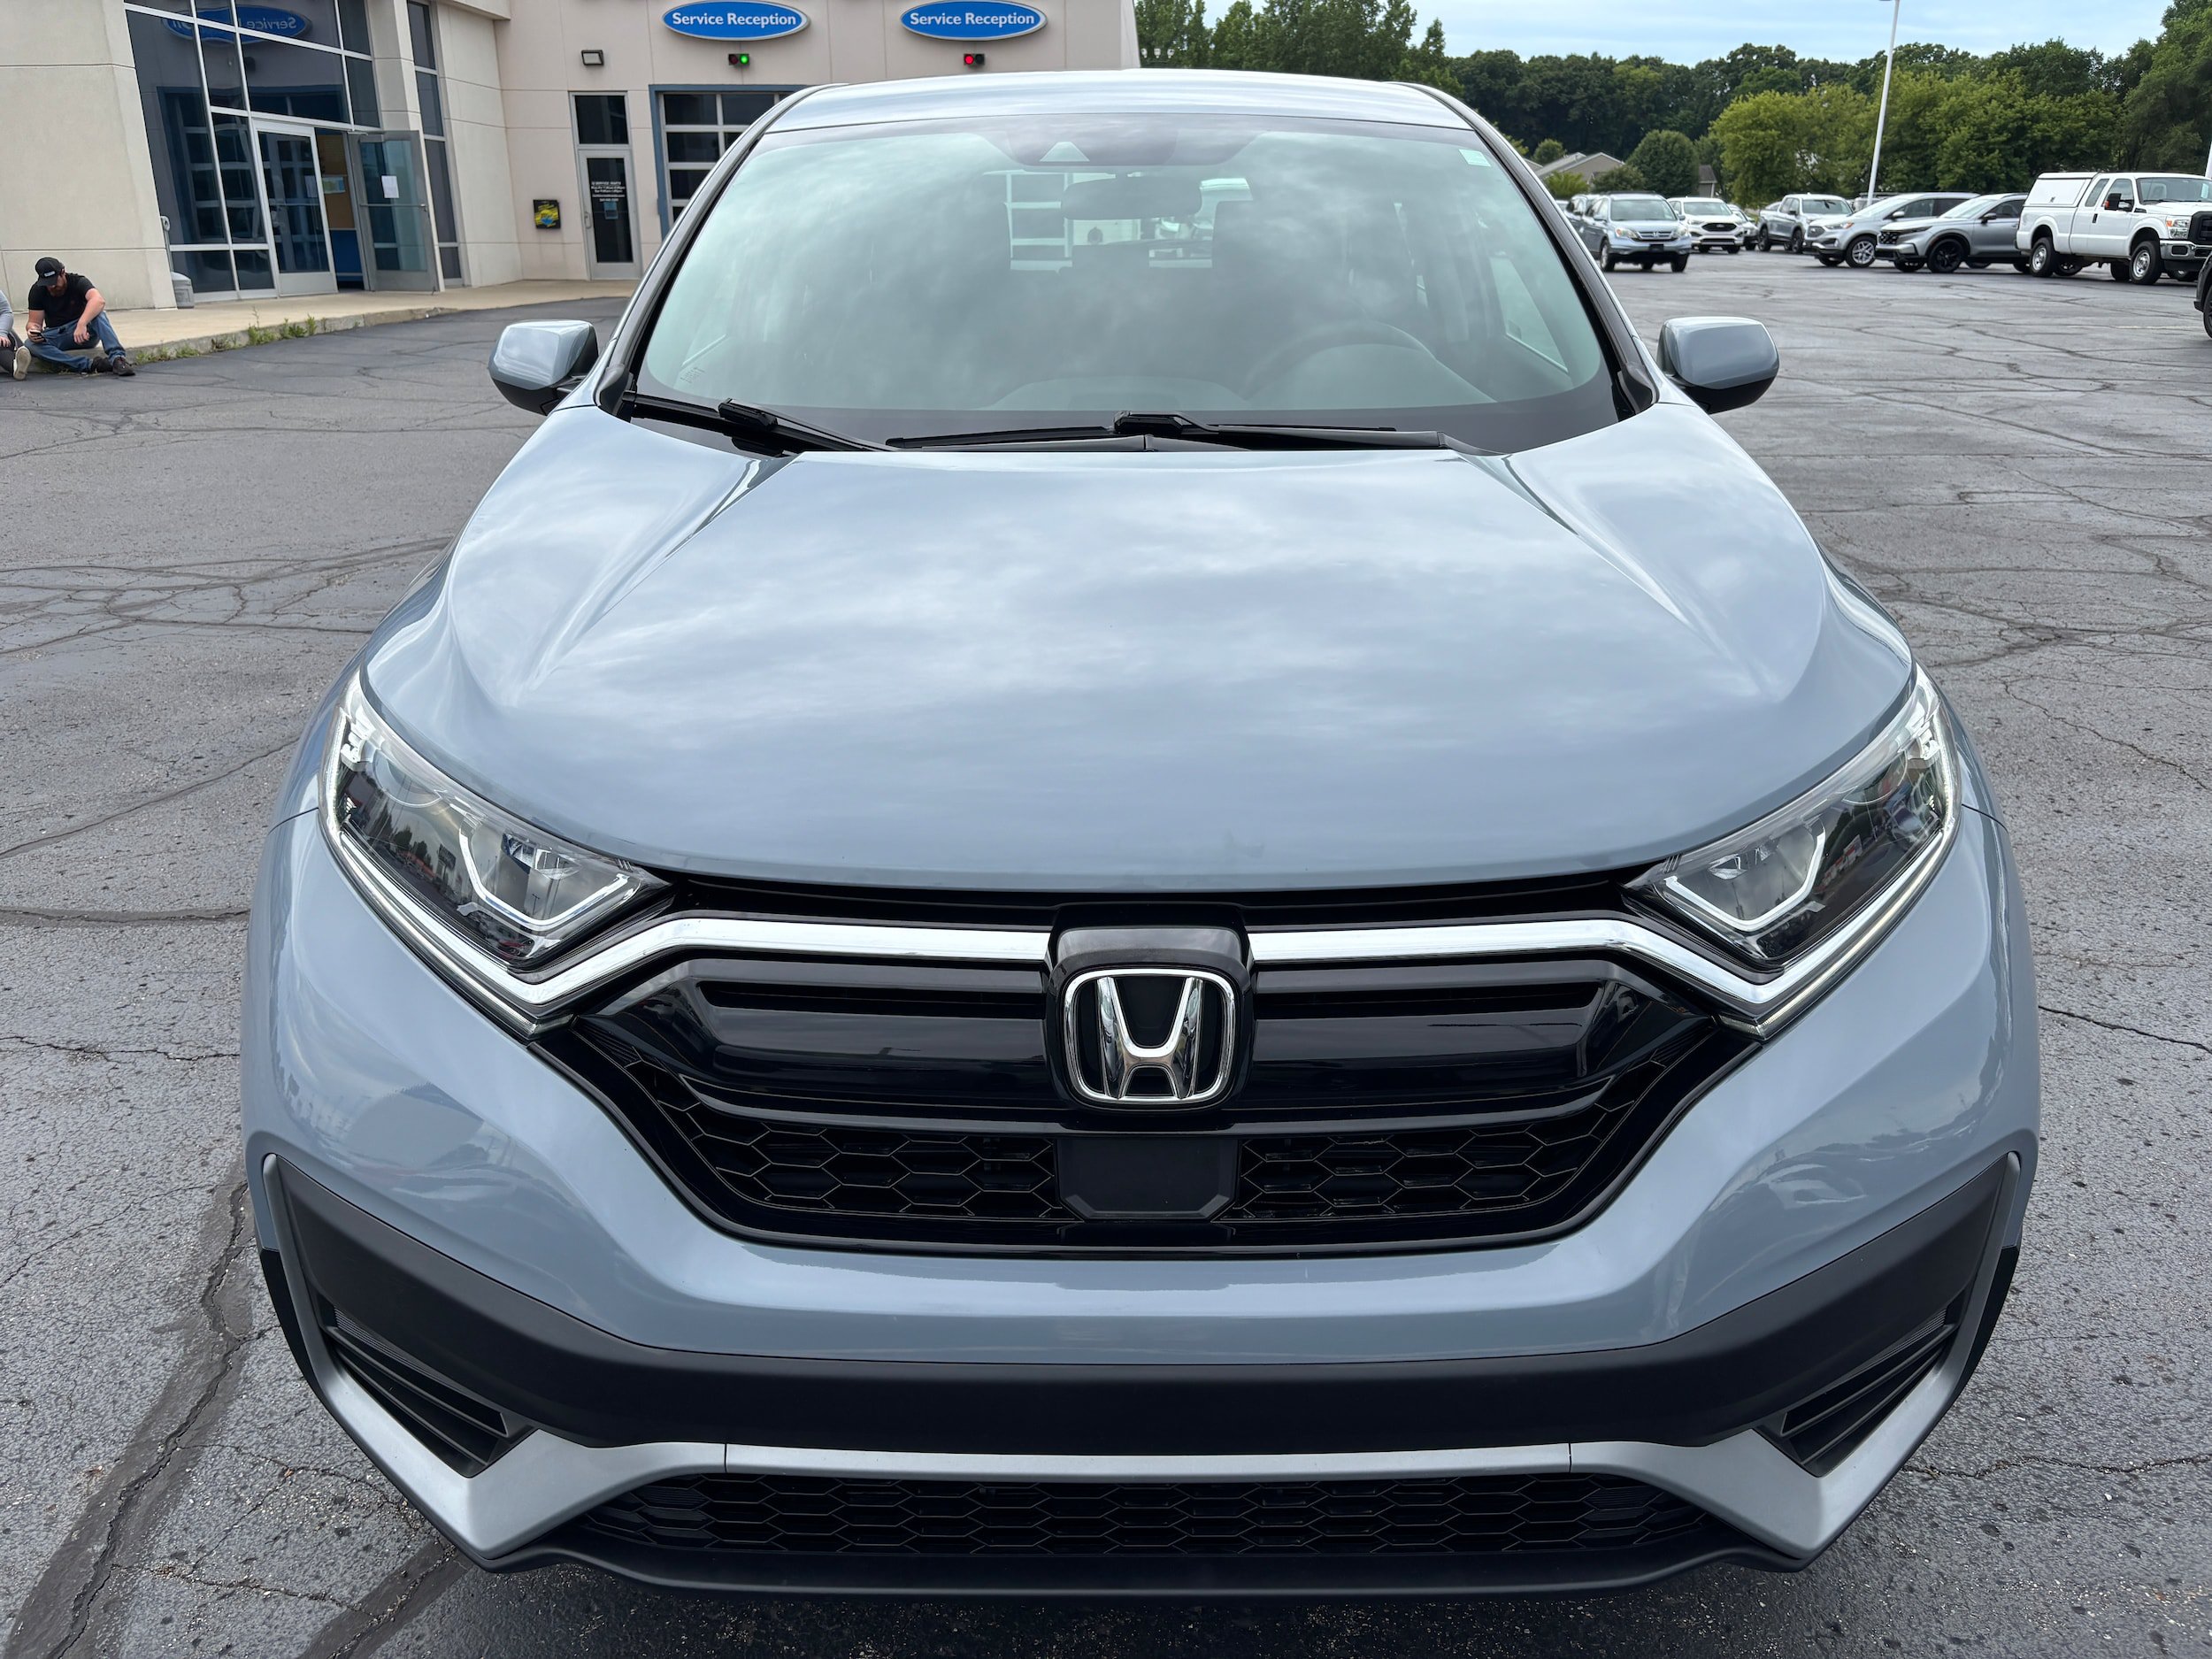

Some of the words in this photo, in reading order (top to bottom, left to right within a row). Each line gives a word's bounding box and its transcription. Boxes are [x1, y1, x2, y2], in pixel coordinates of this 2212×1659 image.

[672, 12, 724, 25] Service
[727, 12, 796, 28] Reception
[910, 12, 962, 25] Service
[964, 12, 1035, 28] Reception
